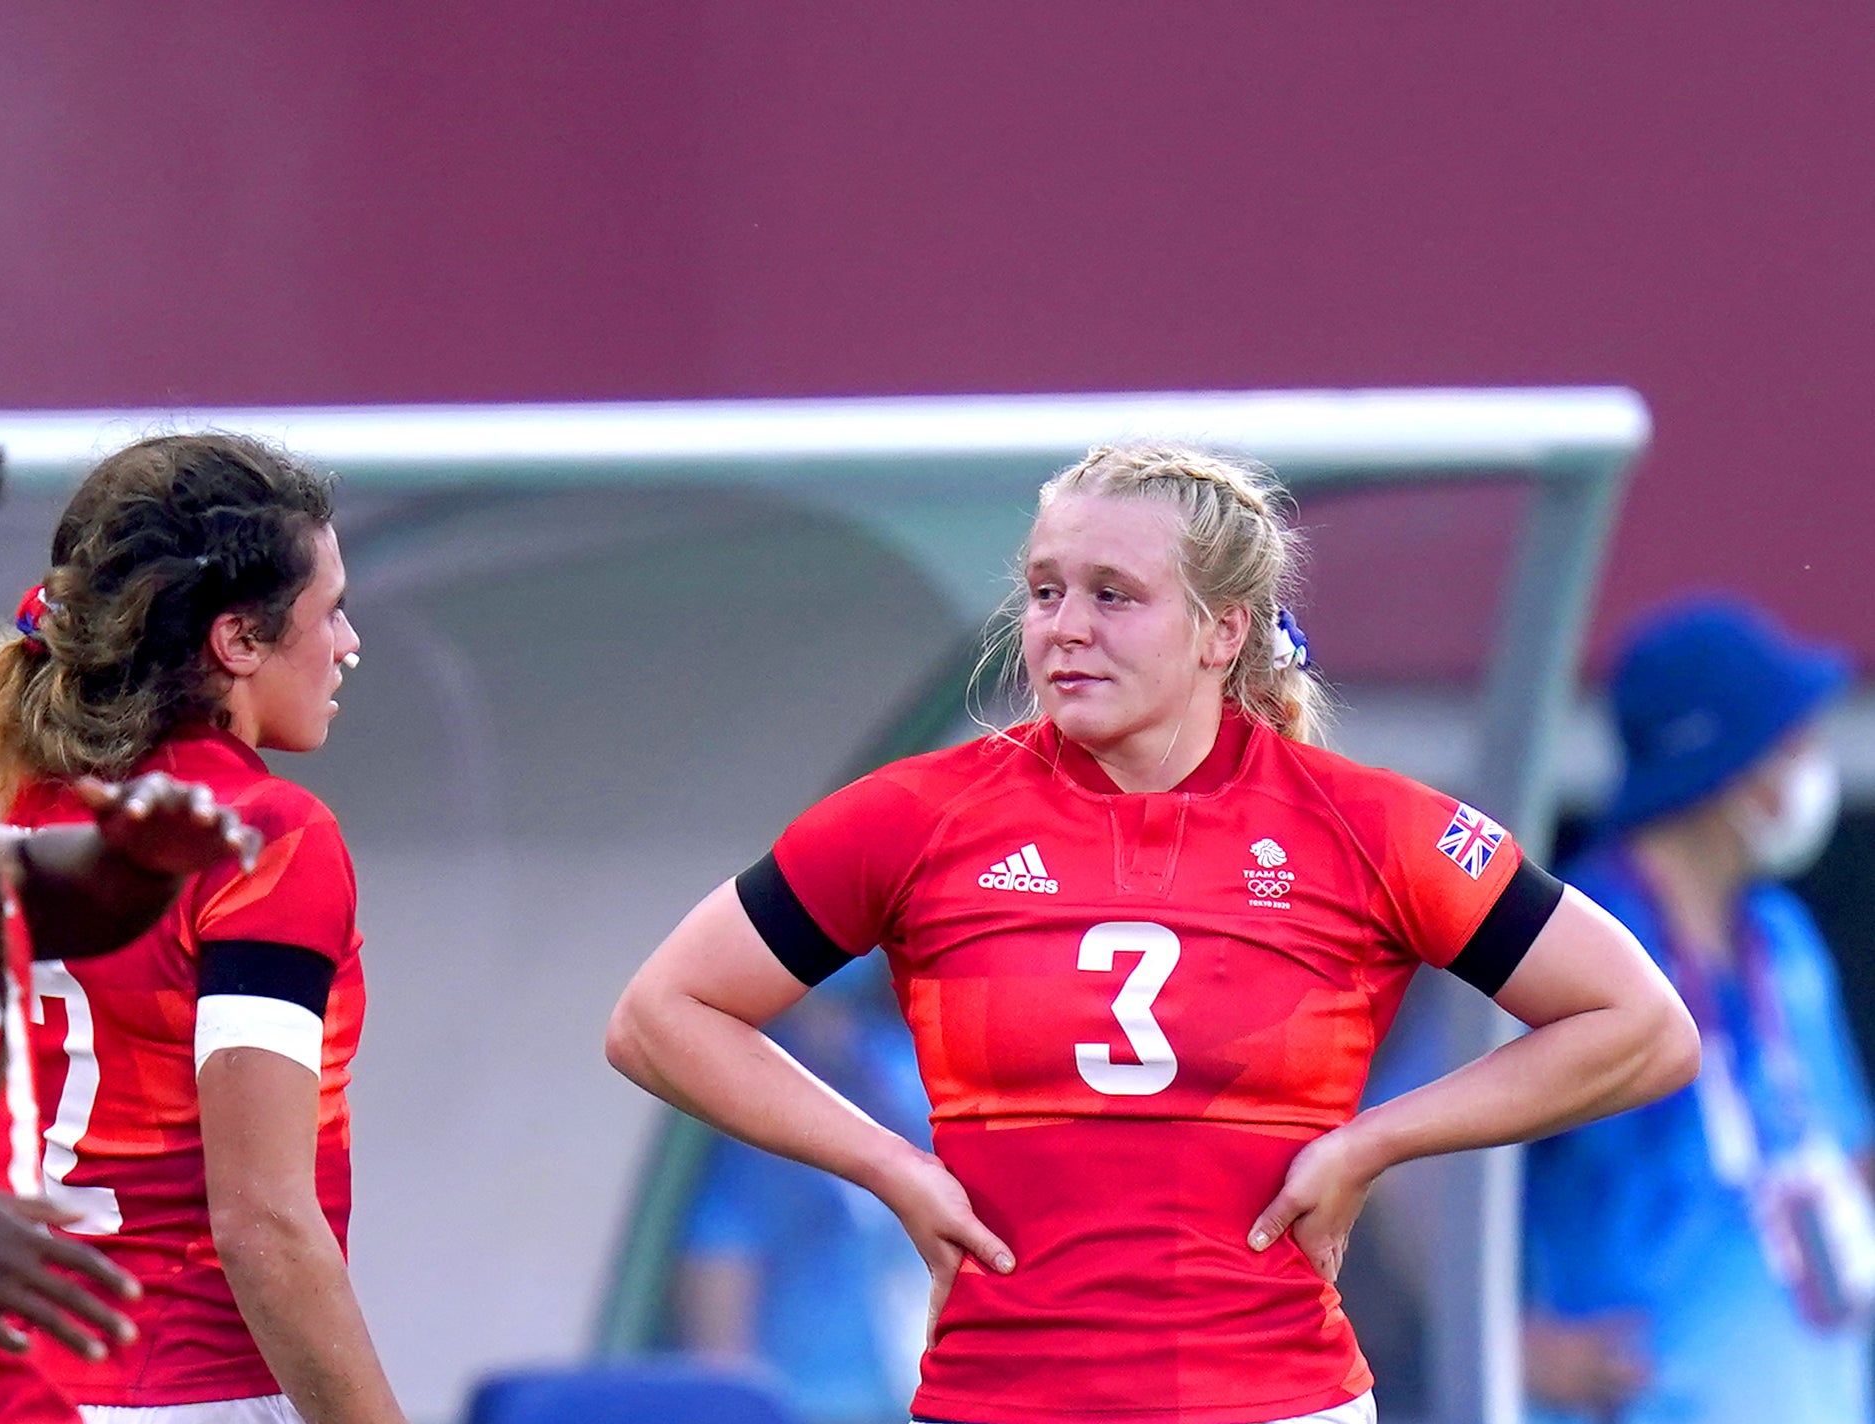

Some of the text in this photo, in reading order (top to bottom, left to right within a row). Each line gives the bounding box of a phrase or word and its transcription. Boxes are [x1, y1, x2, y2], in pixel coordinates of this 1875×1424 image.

[977, 871, 1059, 895] adidas
[1243, 869, 1296, 881] TEAM GB
[1074, 921, 1182, 1096] 3
